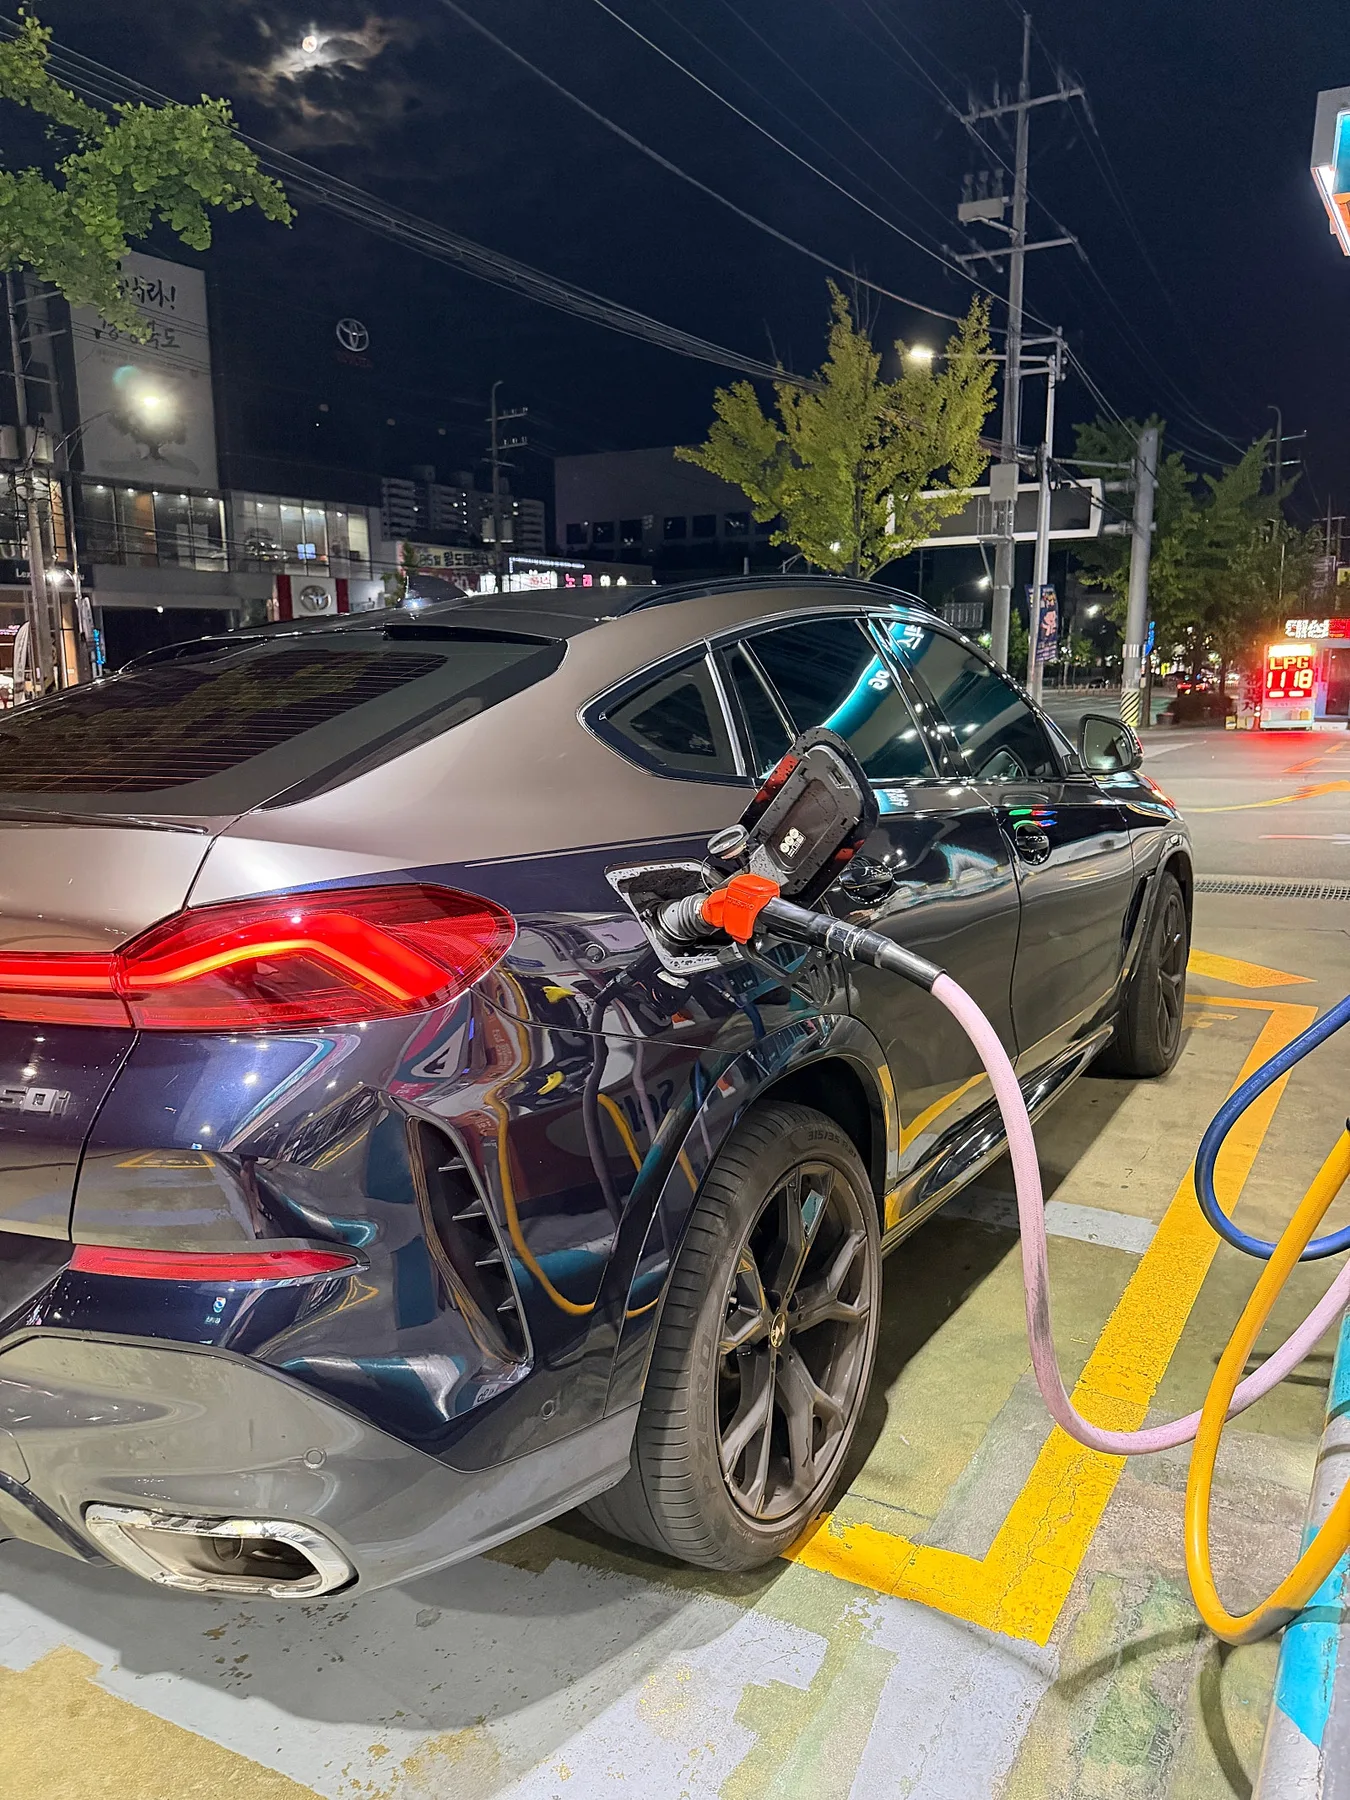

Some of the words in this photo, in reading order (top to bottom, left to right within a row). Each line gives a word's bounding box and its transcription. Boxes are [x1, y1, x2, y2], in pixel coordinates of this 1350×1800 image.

[1270, 656, 1309, 669] LPG
[1266, 669, 1314, 689] 1118
[807, 1130, 841, 1144] 315/35
[696, 1333, 713, 1462] ZERO
